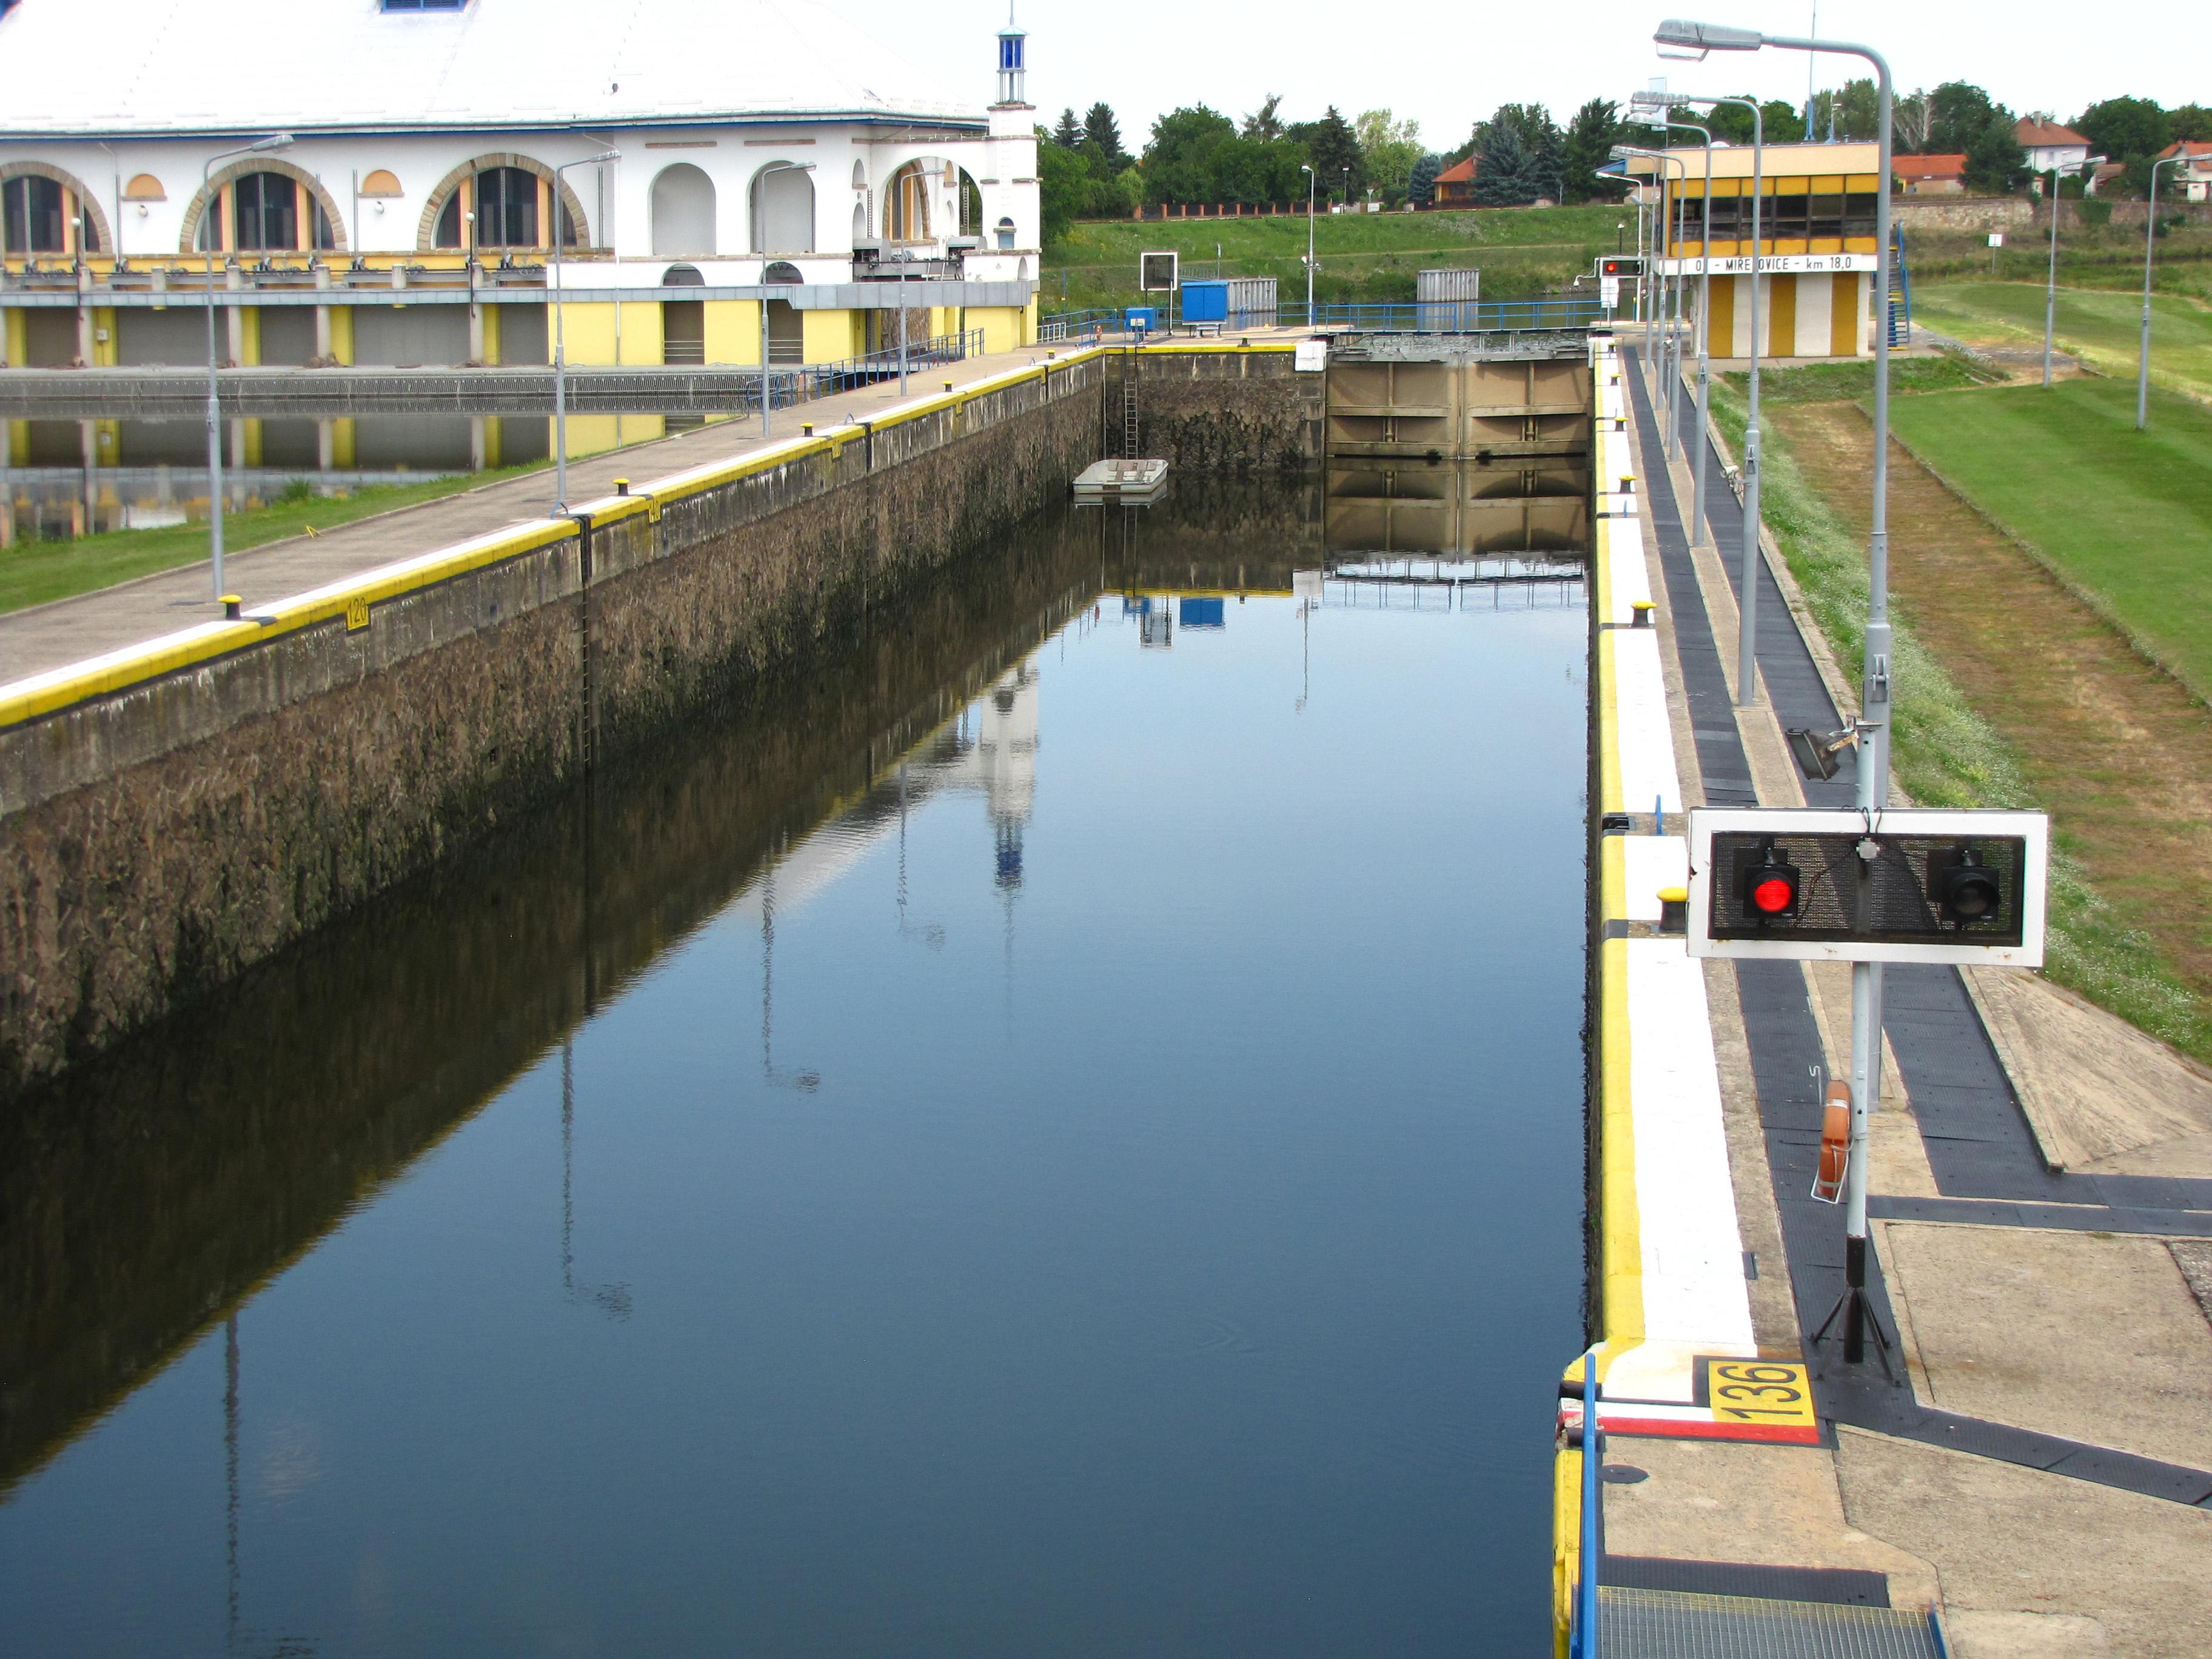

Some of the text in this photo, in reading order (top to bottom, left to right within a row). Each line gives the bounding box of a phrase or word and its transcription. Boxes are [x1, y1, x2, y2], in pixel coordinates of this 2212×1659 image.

[1726, 256, 1789, 271] MIŘEOVICE
[1806, 258, 1823, 269] km
[1830, 256, 1852, 270] 18,0
[348, 597, 366, 625] 120
[1717, 1366, 1803, 1419] 136
